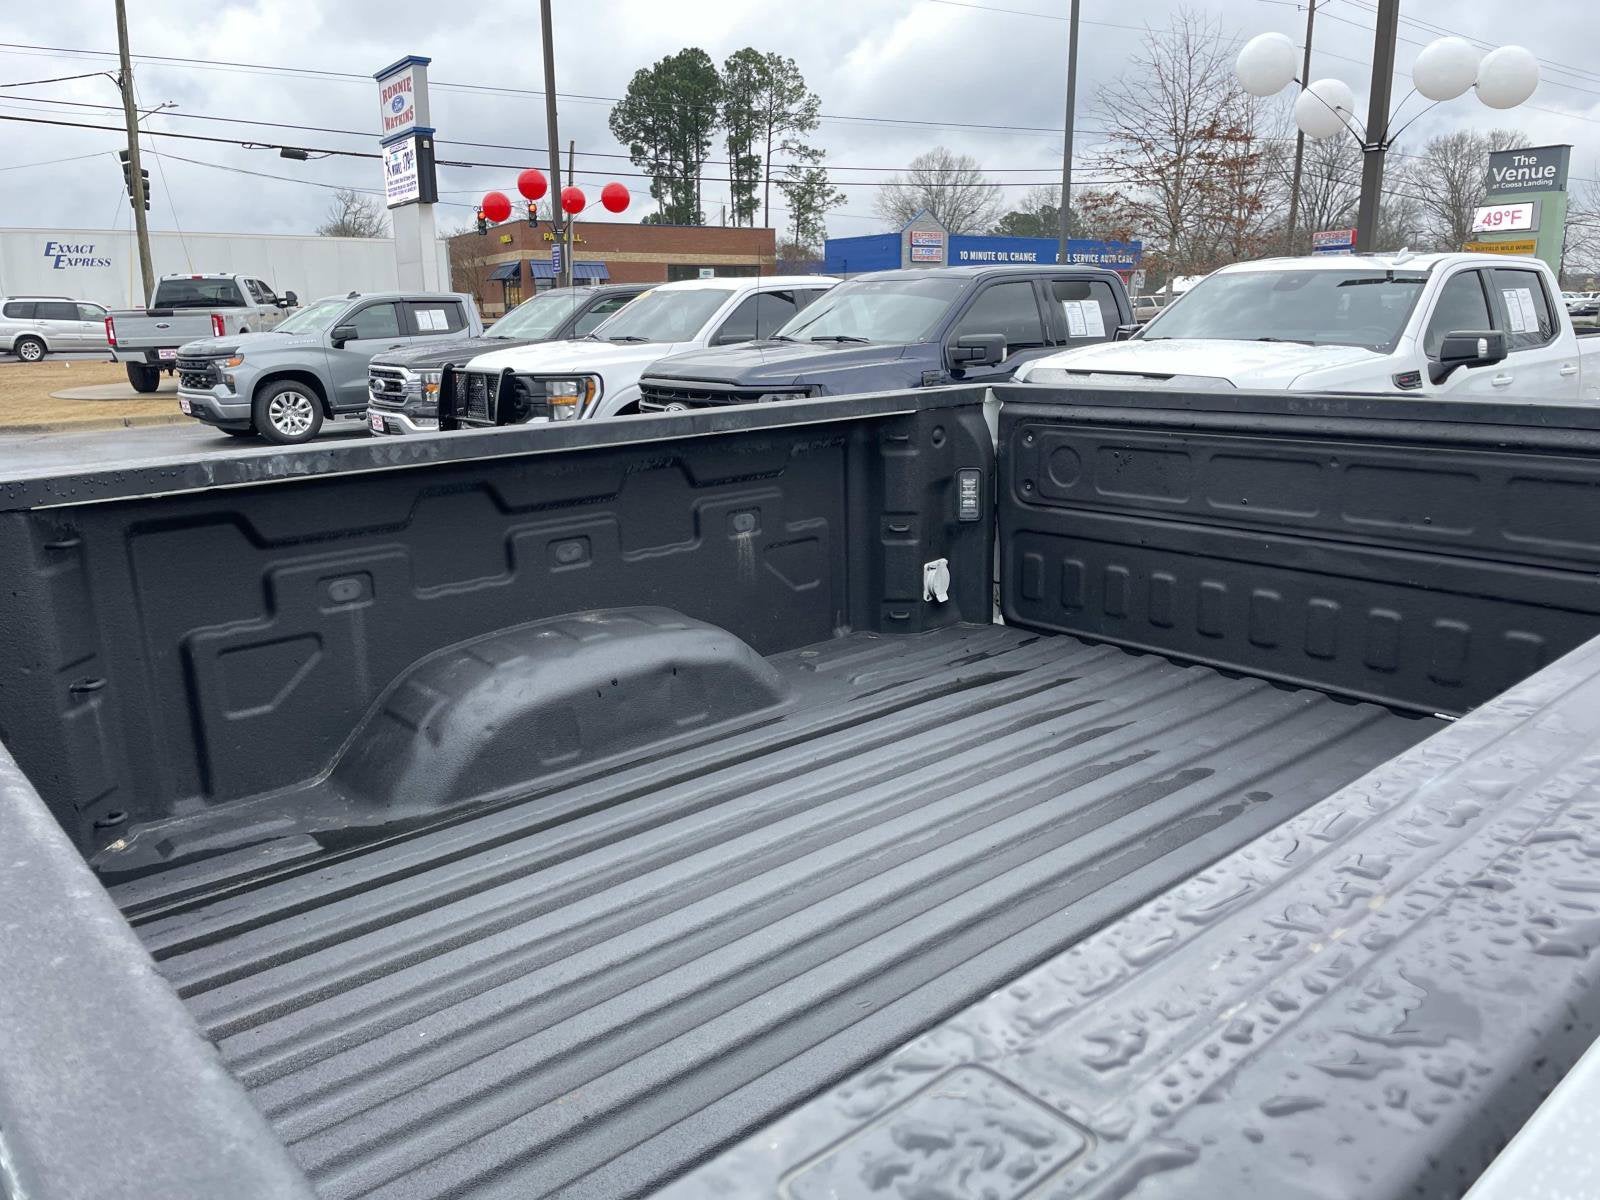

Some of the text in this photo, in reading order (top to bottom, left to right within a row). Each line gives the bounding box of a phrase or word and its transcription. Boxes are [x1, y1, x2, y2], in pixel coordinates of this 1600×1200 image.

[382, 76, 412, 104] RONNIE
[384, 105, 414, 131] WATKINS
[1513, 155, 1537, 166] The
[1493, 165, 1556, 181] Venue
[1501, 181, 1522, 189] Coosa
[1524, 179, 1553, 187] Landing
[1482, 210, 1522, 227] 49°F
[44, 242, 95, 257] EXXACT
[960, 251, 1037, 261] 10 MINUTE OIL CHANGE
[53, 255, 112, 270] EXPRESS
[1056, 253, 1071, 263] FL
[1073, 253, 1099, 263] SERVICE
[1100, 254, 1117, 263] AUTO
